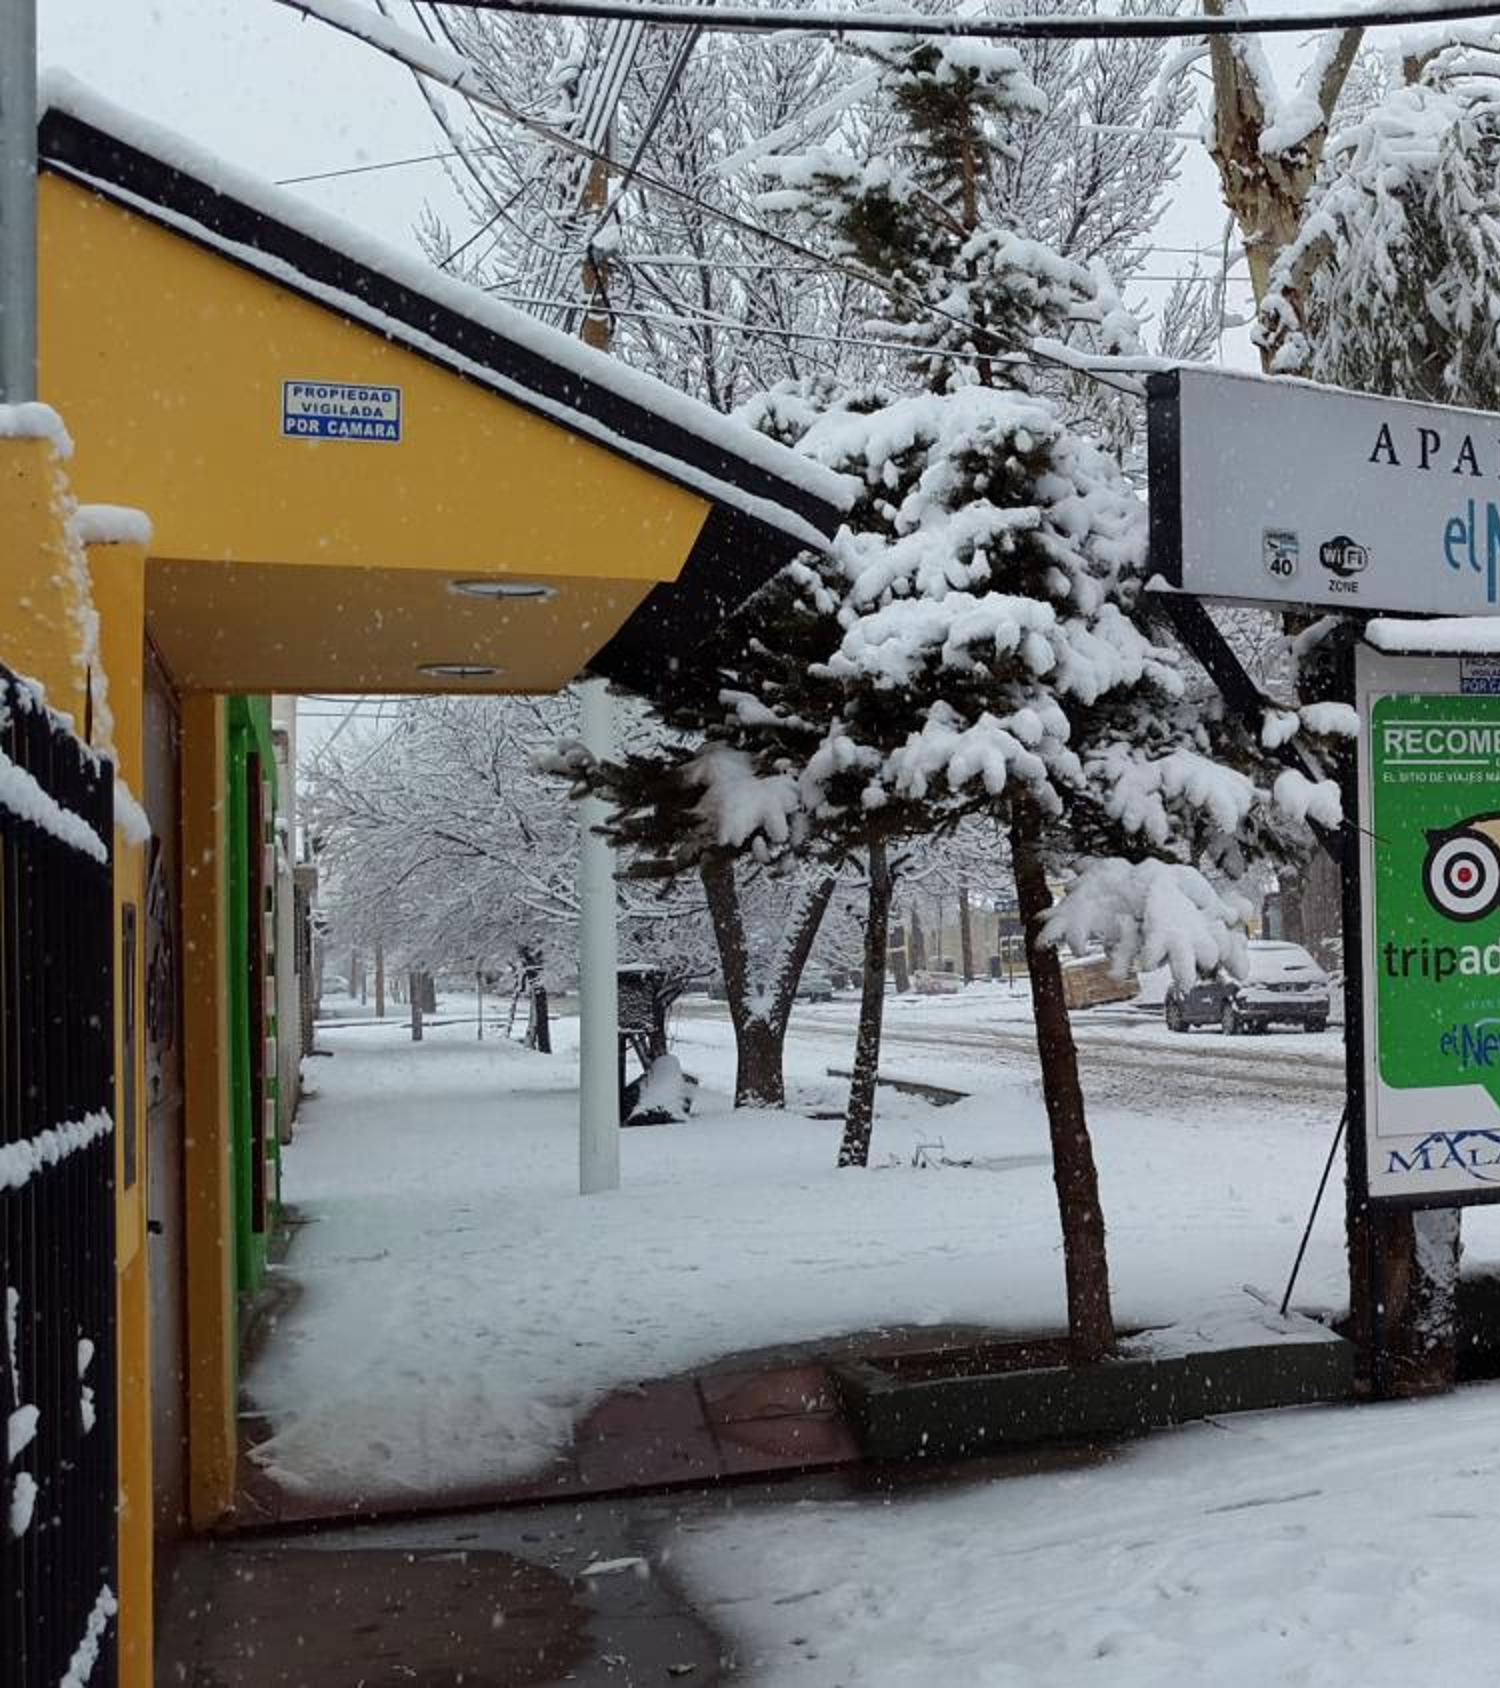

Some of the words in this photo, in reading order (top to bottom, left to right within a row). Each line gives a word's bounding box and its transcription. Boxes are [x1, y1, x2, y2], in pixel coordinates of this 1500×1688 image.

[293, 386, 392, 403] PROPIEDAD
[301, 402, 384, 418] VIGILADA
[286, 418, 320, 433] POR
[327, 421, 397, 438] CAMARA
[1270, 559, 1293, 576] 40
[1328, 579, 1359, 593] ZONE
[1383, 772, 1396, 782] EL
[1429, 772, 1443, 783] DE
[1446, 772, 1482, 783] VIAJES
